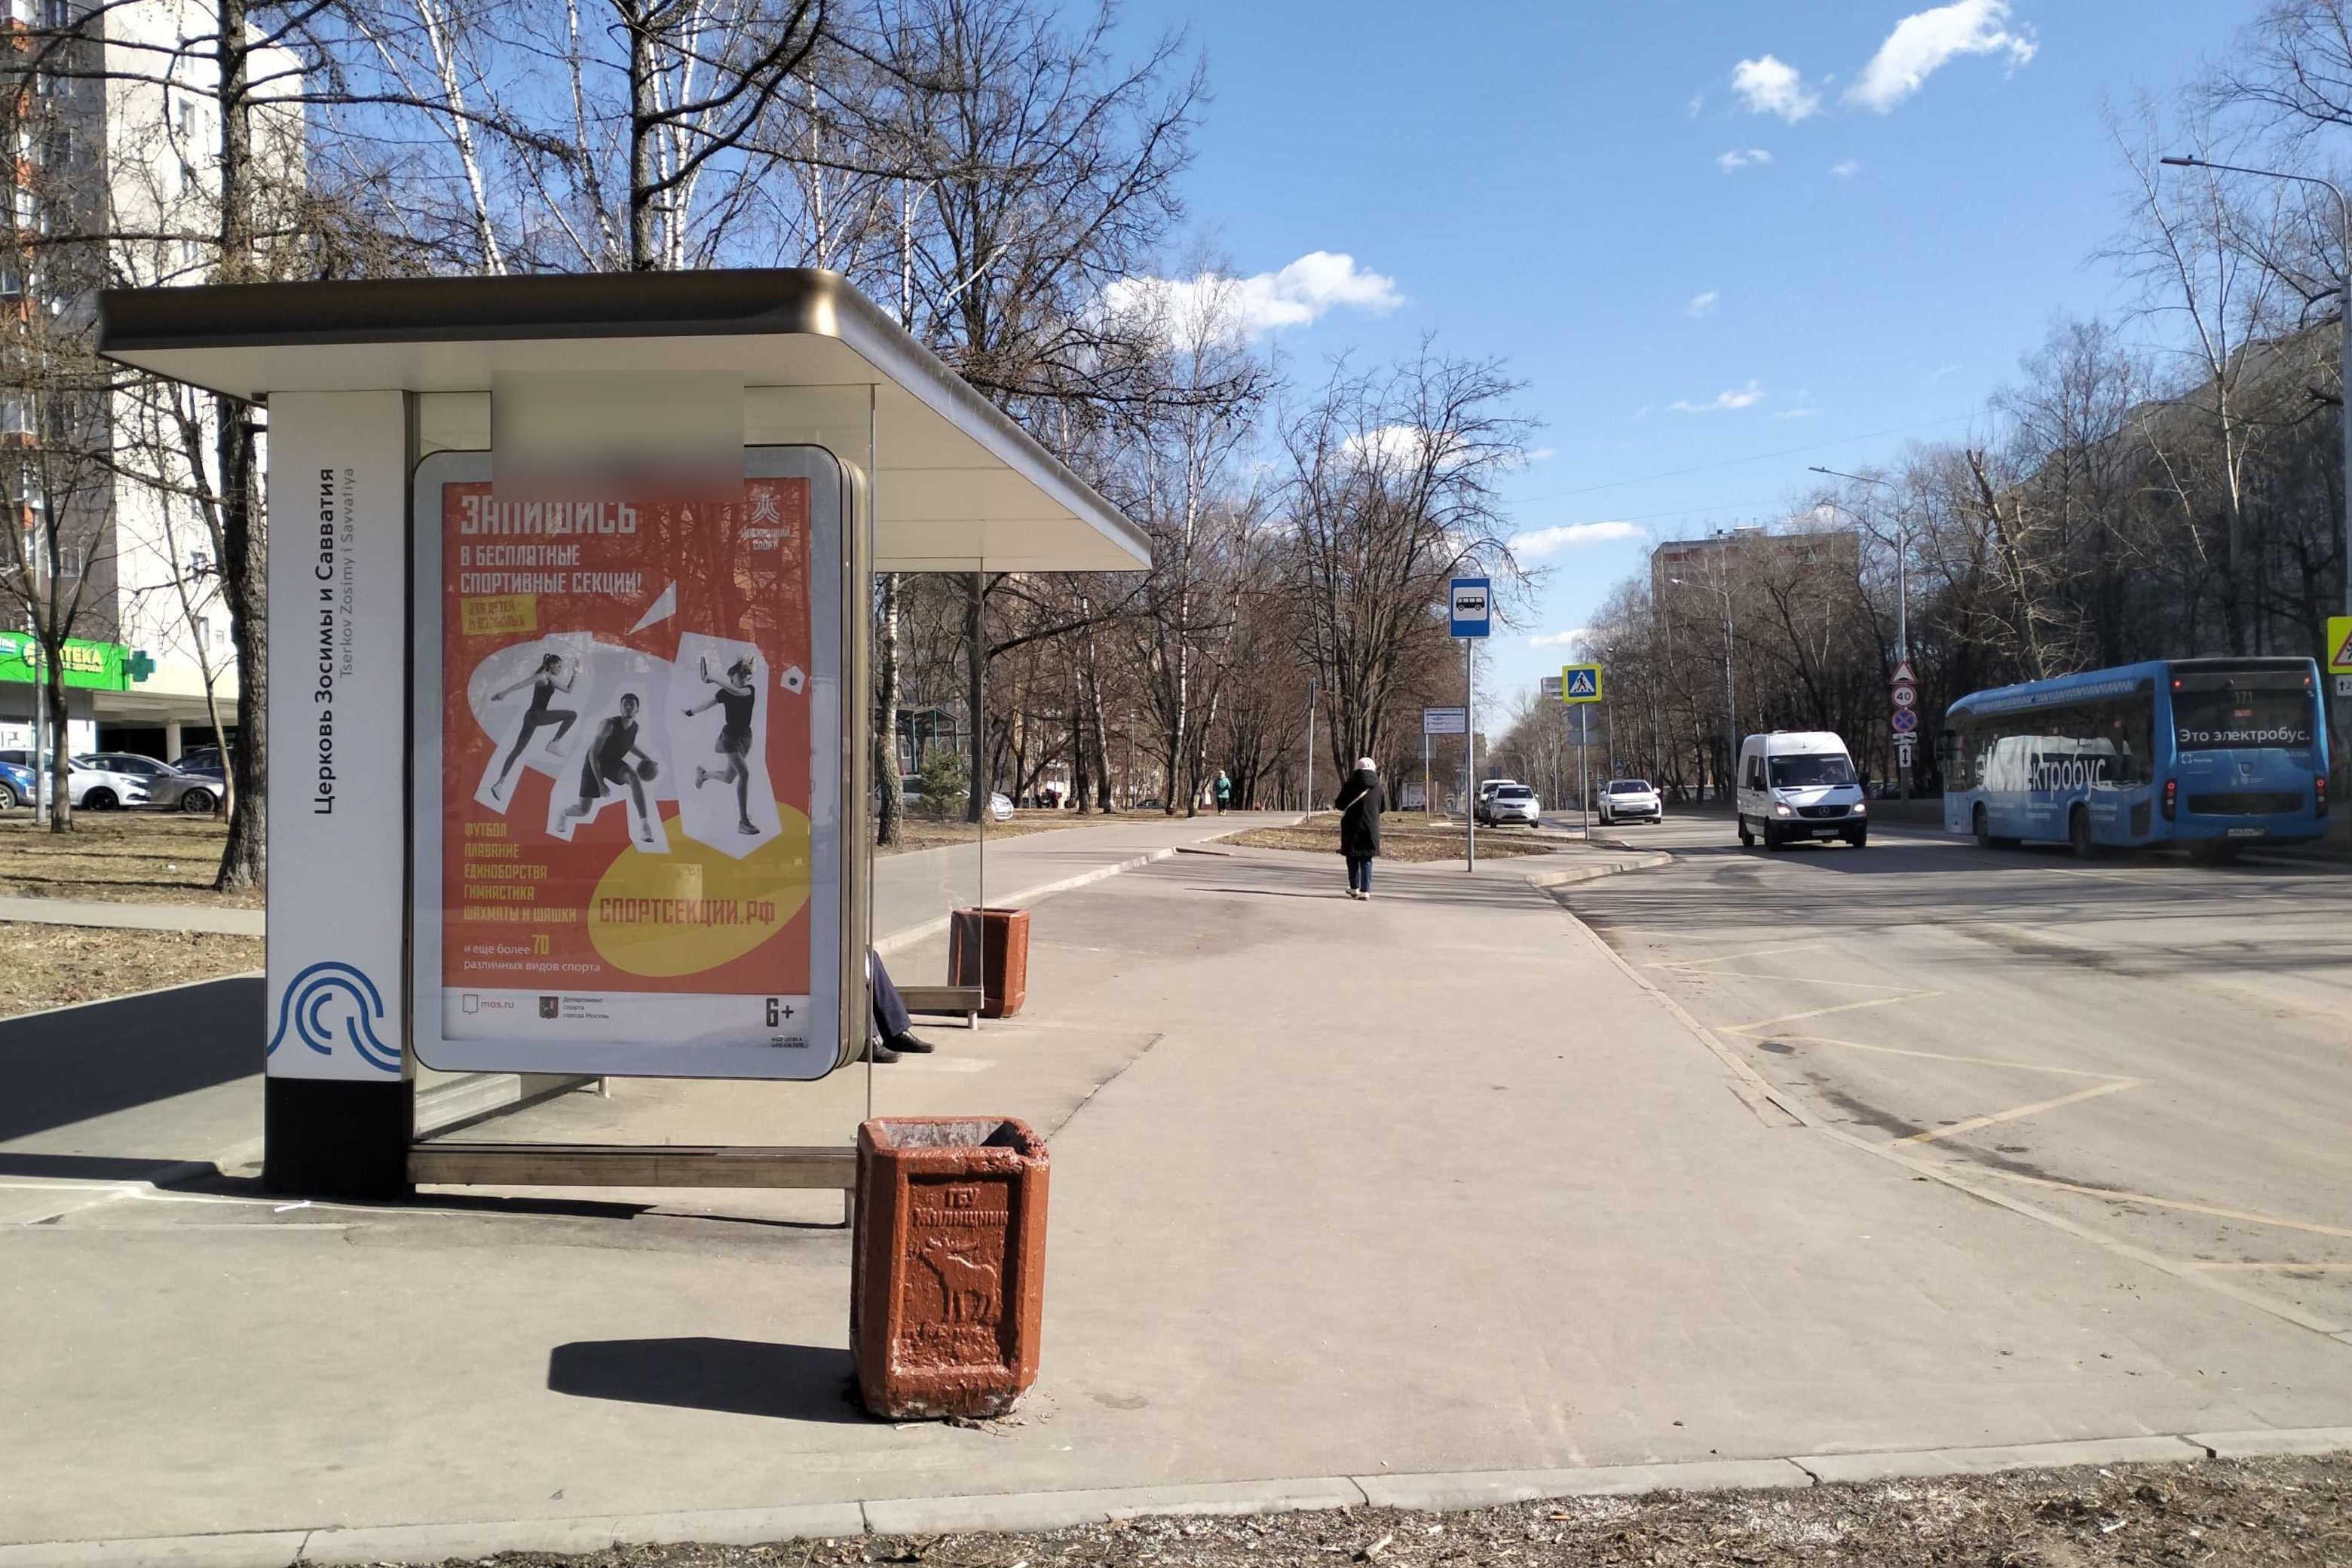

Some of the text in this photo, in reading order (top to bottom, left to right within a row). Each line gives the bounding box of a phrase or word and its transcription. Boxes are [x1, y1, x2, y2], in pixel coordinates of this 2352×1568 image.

[340, 467, 356, 543] Savvatiya
[461, 495, 635, 534] ЗАПИШИСЬ
[461, 544, 580, 566] В БЕСПЛАТНЫЕ
[340, 557, 356, 614] Zosimy
[461, 571, 642, 596] СПОРТИВНЫЕ СЕКЦИИ!
[314, 468, 336, 815] Церковь Зосимы и Савватия
[340, 620, 354, 678] Tserkov
[1897, 692, 1911, 700] 40
[2234, 691, 2252, 704] 171
[2179, 727, 2311, 743] Это электробус.
[465, 822, 507, 838] ФУТБОЛ
[464, 844, 519, 858] ПЛАВАНИЕ
[464, 864, 547, 880] ЕДИНОБОРСТВА
[464, 885, 534, 900] ГИМНАСТИКА
[464, 905, 576, 923] ШАХМАТЫ И ШАШКИ
[599, 897, 775, 926] СПОРТСЕКЦИИ.РФ
[464, 934, 549, 955] и еще более 70
[464, 960, 600, 975] различных видов спорта
[481, 1000, 514, 1009] mos.ru
[767, 998, 794, 1027] 6+
[945, 1187, 980, 1208] ГБУ
